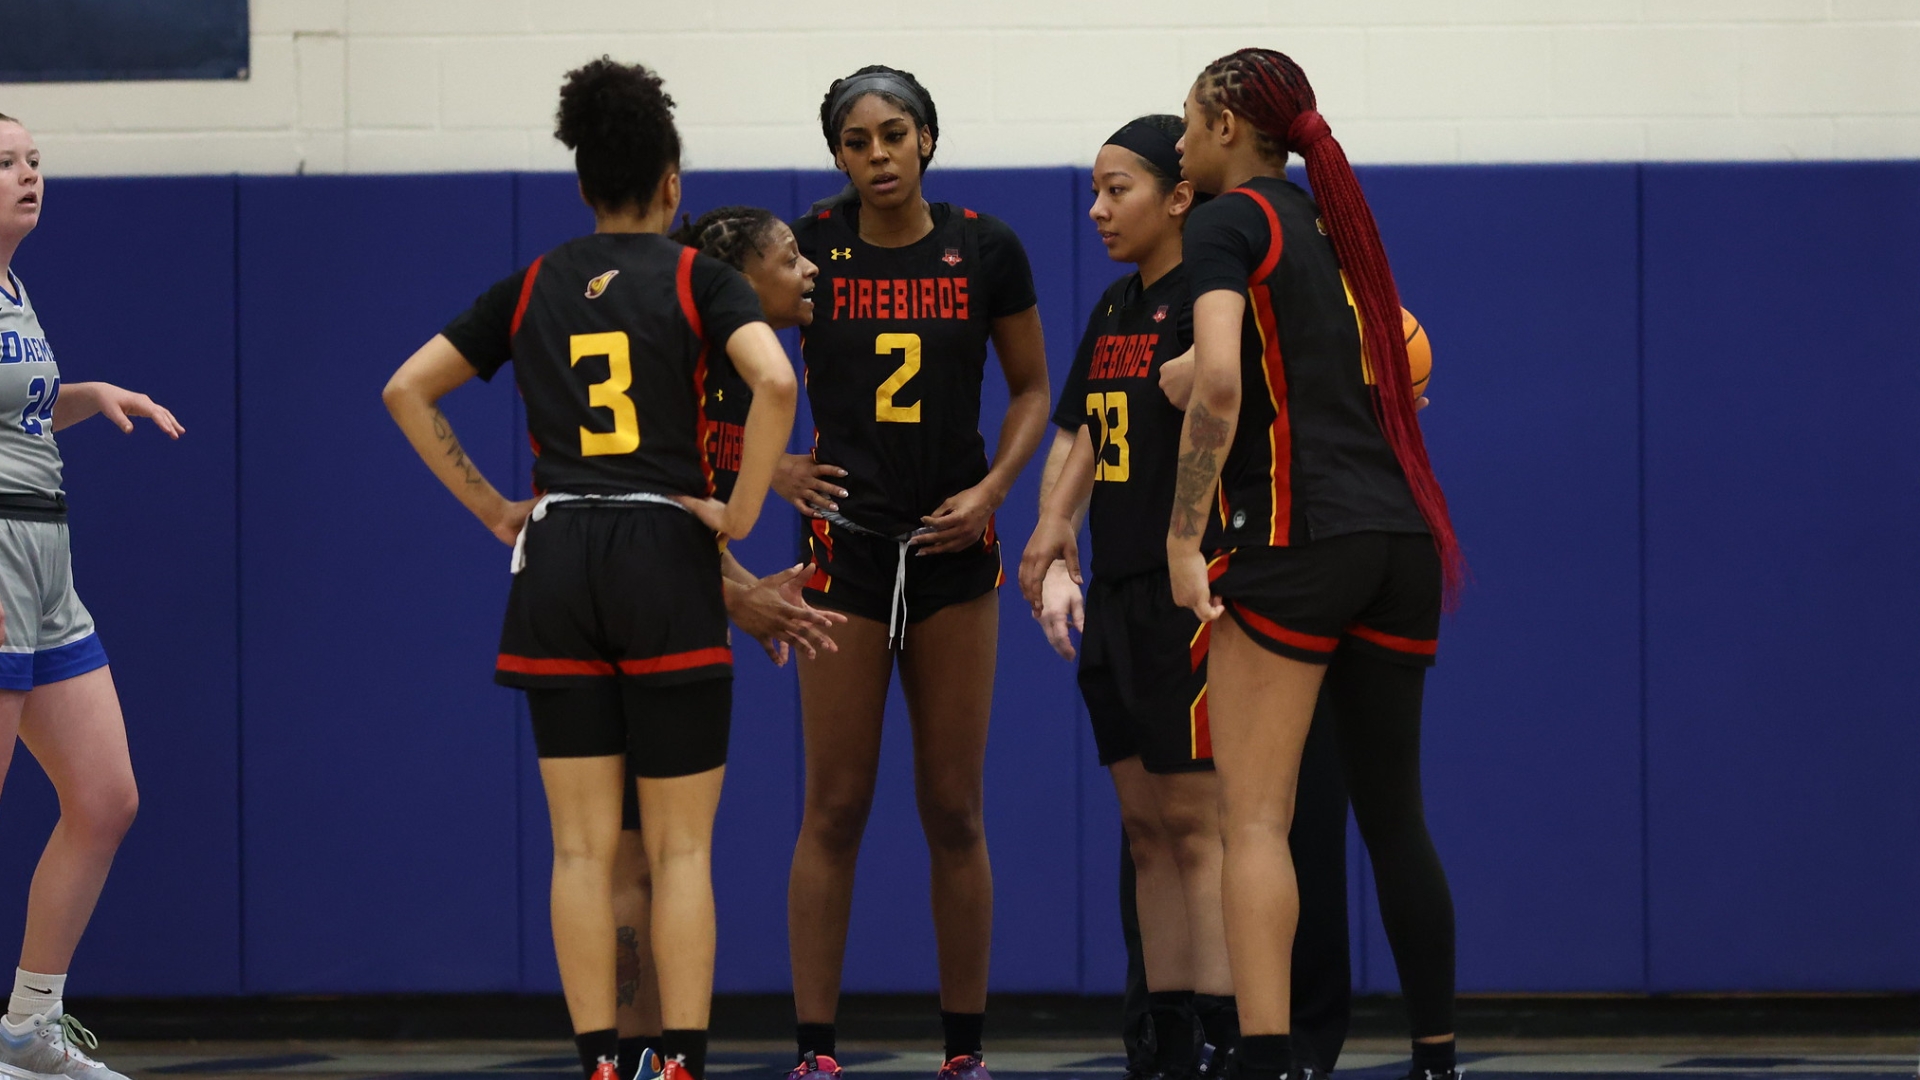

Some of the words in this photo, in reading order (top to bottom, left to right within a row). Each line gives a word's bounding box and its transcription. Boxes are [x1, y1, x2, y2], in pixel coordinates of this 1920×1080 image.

[832, 277, 970, 321] FIREBIRDS
[0, 331, 56, 363] DAEM
[875, 332, 921, 423] 2
[569, 330, 641, 457] 3
[1085, 391, 1130, 483] 23
